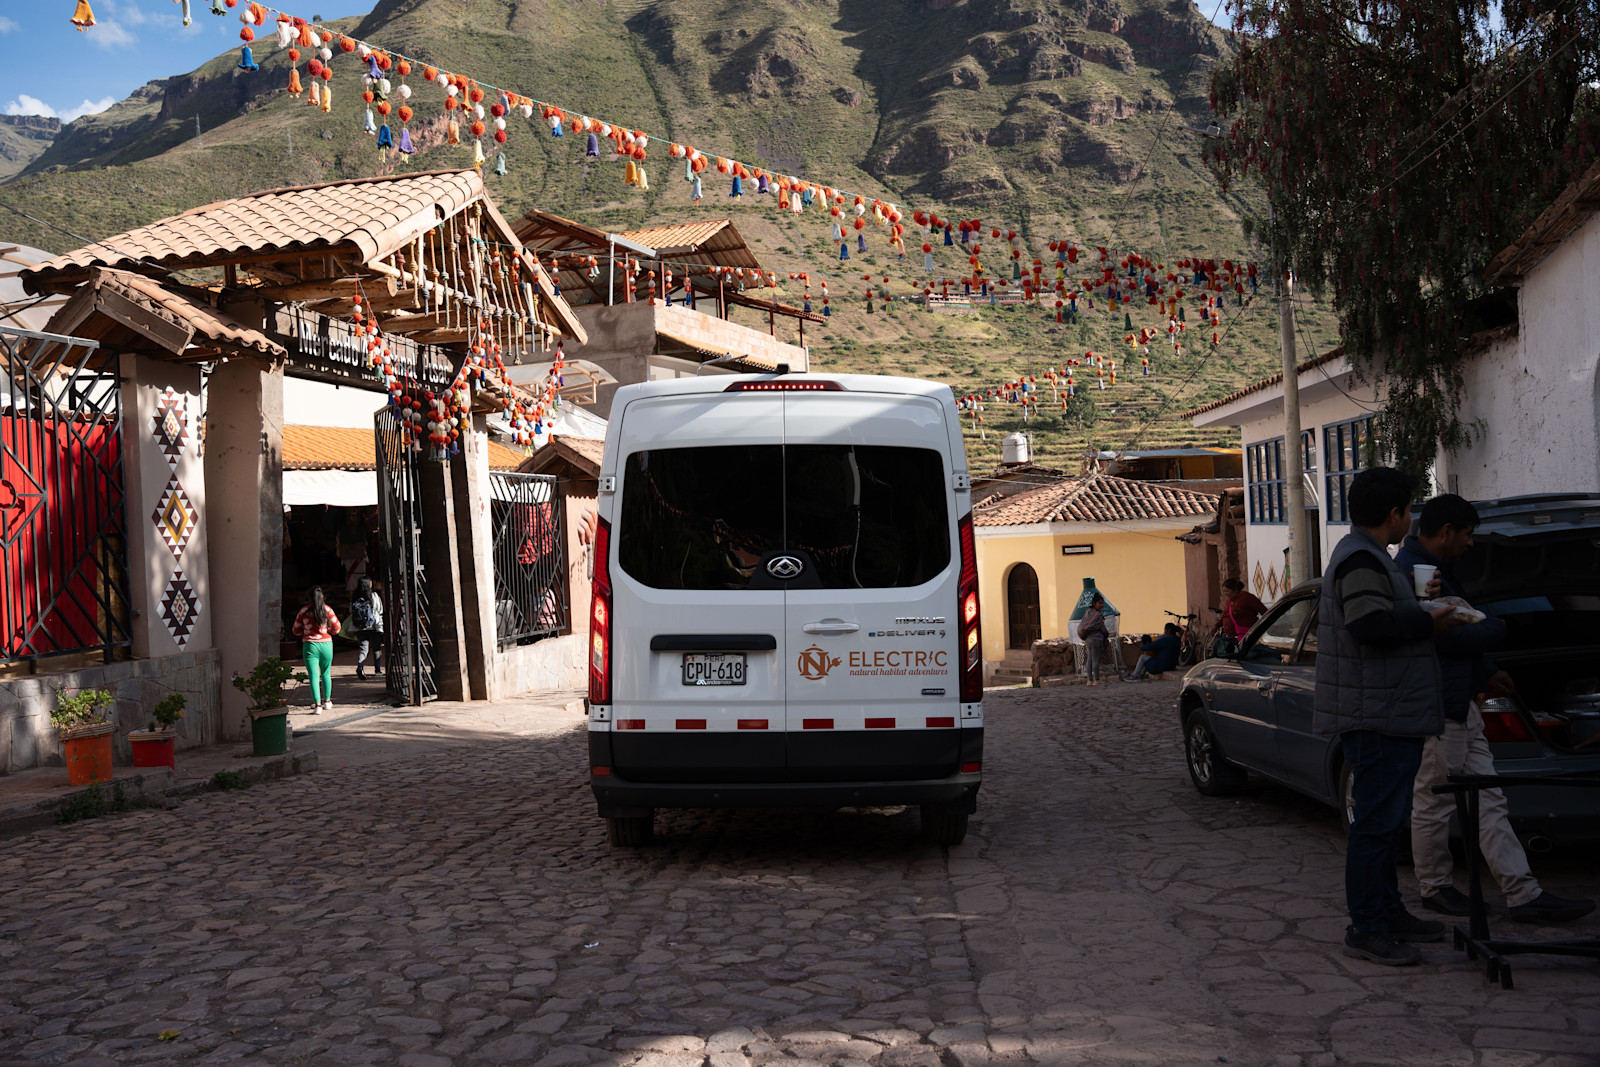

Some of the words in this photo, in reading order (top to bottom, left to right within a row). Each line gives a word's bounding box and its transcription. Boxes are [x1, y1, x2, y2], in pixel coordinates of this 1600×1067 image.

[299, 320, 359, 367] Mercado
[895, 616, 946, 625] MAXUS
[939, 629, 946, 639] 9
[687, 662, 742, 679] CPU-618
[849, 668, 879, 676] natural
[880, 668, 907, 676] habitat
[908, 668, 948, 676] adventures
